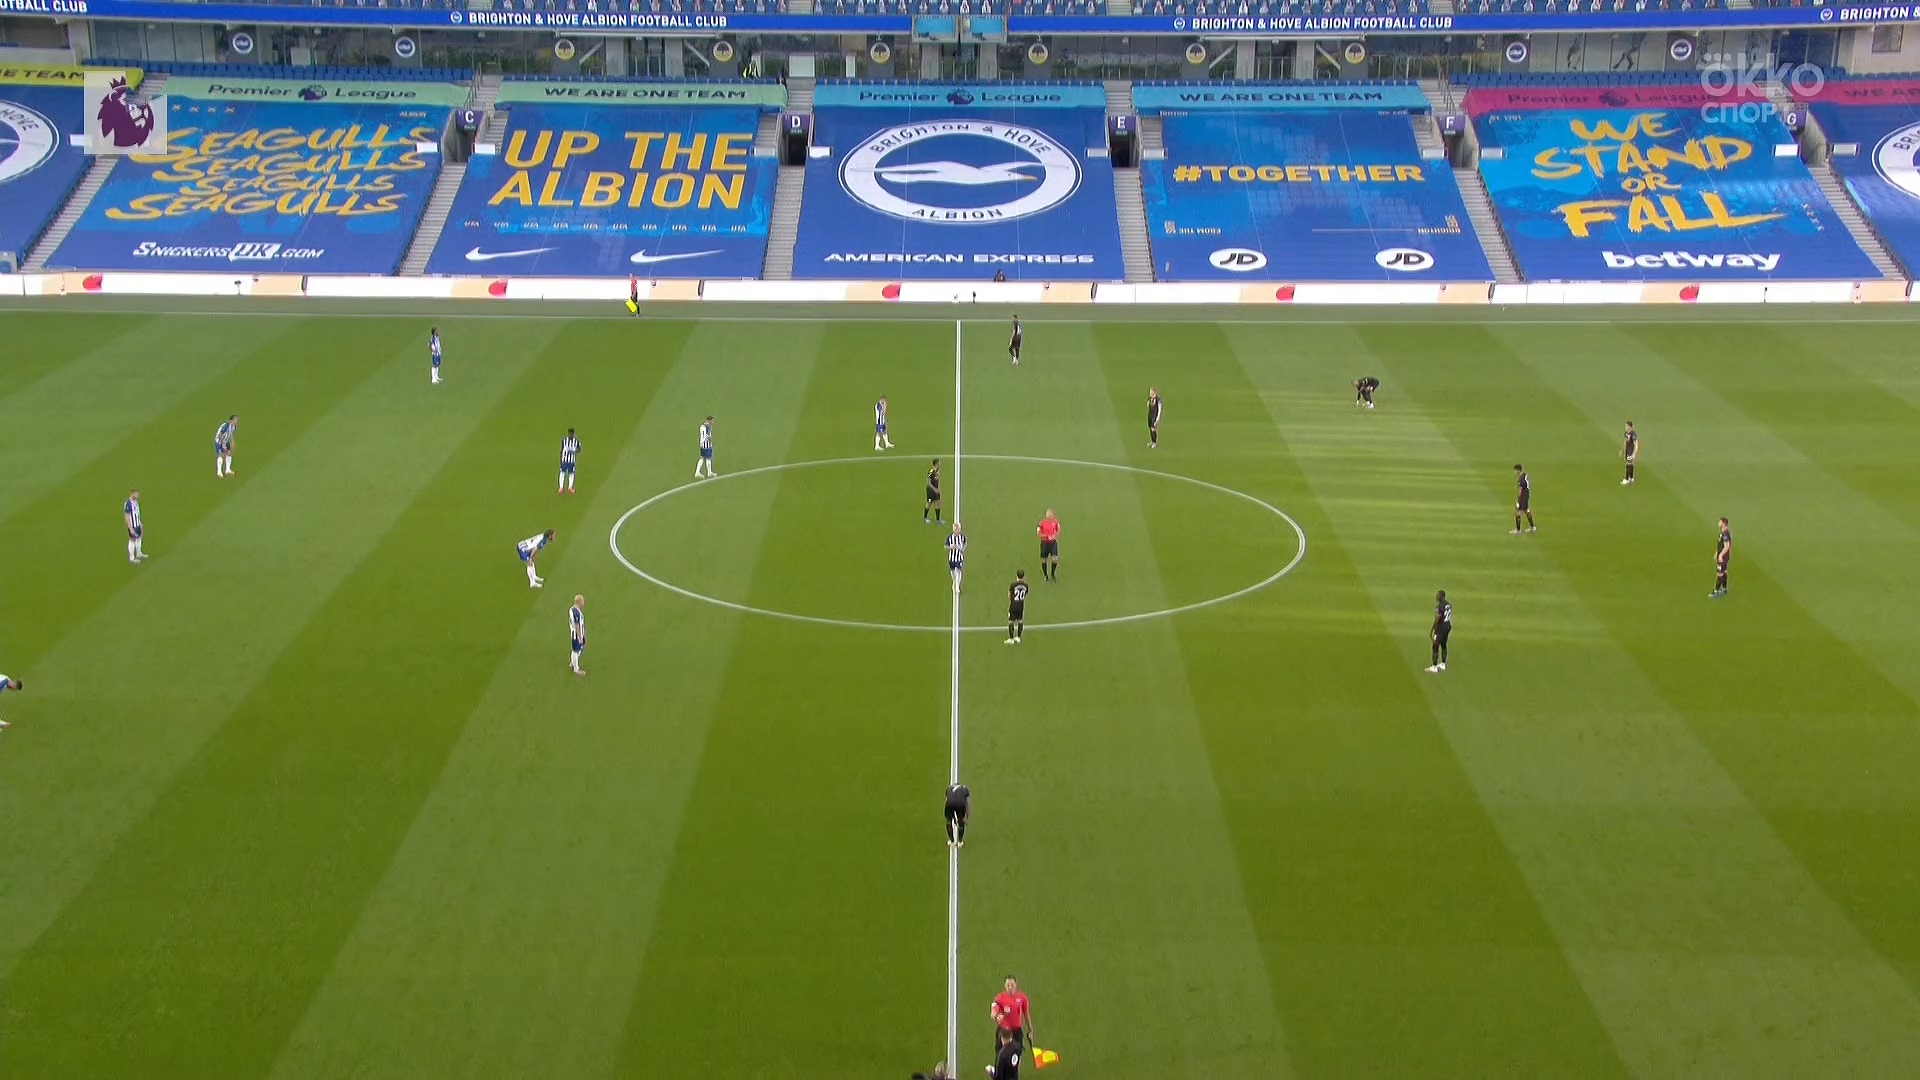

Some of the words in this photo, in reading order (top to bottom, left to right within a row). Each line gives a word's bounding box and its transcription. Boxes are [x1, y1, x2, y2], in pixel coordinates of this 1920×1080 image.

[52, 0, 88, 13] CLUB
[1840, 7, 1909, 20] BRIGHTON
[1912, 6, 1920, 17] &
[469, 13, 531, 25] BRIGHTON
[535, 14, 544, 25] &
[548, 14, 579, 25] HOVE
[582, 14, 627, 26] ALBION
[631, 15, 692, 27] FOOTBALL
[696, 16, 727, 27] CLUB
[1192, 18, 1254, 29] BRIGHTON
[1258, 18, 1266, 28] &
[1270, 18, 1301, 29] HOVE
[1305, 17, 1350, 29] ALBION
[1354, 17, 1416, 29] FOOTBALL
[1419, 17, 1452, 28] CLUB
[23, 70, 84, 80] TEAM
[208, 84, 292, 97] Premier
[335, 87, 417, 99] League
[545, 88, 580, 98] WE
[585, 88, 628, 98] ARE
[632, 89, 679, 98] ONE
[684, 90, 746, 99] TEAM
[859, 92, 939, 102] Premier
[981, 92, 1062, 103] League
[1180, 93, 1215, 102] WE
[1219, 93, 1264, 102] ARE
[1268, 93, 1316, 102] ONE
[1318, 92, 1382, 102] TEAM
[465, 110, 474, 123] C
[791, 116, 801, 128] D
[1116, 116, 1126, 128] E
[1446, 116, 1455, 129] F
[1787, 112, 1797, 125] G
[1570, 112, 1682, 140] WE
[129, 123, 437, 163] SEAGULLS
[869, 122, 970, 154] BRIGHTON
[981, 125, 994, 134] &
[1003, 129, 1052, 155] HOVE
[504, 130, 600, 169] UP
[624, 132, 753, 171] THE
[1531, 134, 1752, 178] STAND
[152, 150, 426, 182] SEAGULLS
[1172, 164, 1426, 183] #TOGETHER
[180, 174, 397, 195] SEAGULLS
[488, 170, 746, 209] ALBION
[1621, 172, 1682, 194] OR
[105, 190, 408, 220] SEAGULLS
[911, 207, 1004, 220] ALBION
[1551, 191, 1788, 238] FALL
[823, 252, 964, 263] AMERICAN
[973, 253, 1096, 264] EXPRESS
[1219, 252, 1259, 266] JD
[1386, 252, 1425, 266] JD
[1601, 250, 1781, 271] betway
[1014, 589, 1025, 601] 20
